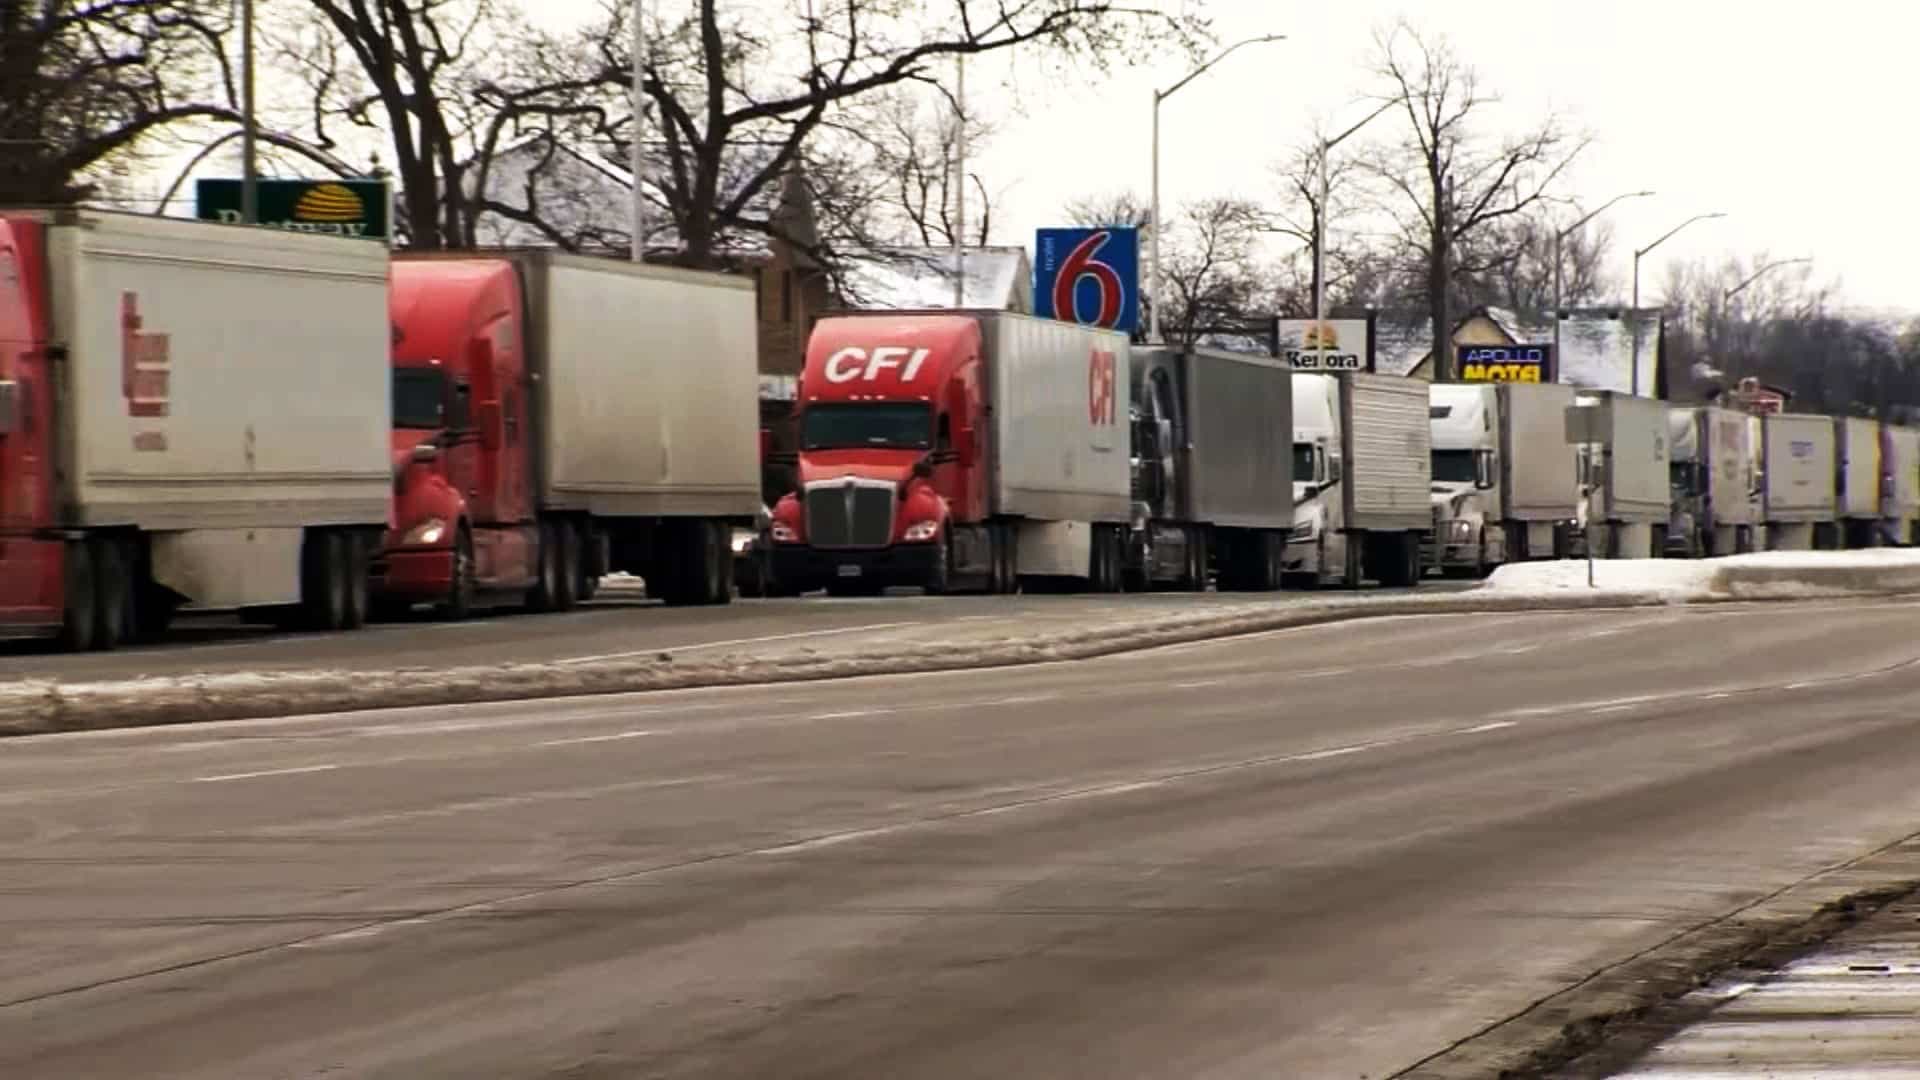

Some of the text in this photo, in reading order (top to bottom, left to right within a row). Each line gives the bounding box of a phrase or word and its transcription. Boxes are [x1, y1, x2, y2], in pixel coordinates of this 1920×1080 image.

[1053, 231, 1124, 328] 6
[824, 346, 931, 383] CFI
[1464, 364, 1541, 384] MOTEL
[1466, 349, 1542, 362] APOLLO
[1089, 349, 1116, 425] CFI
